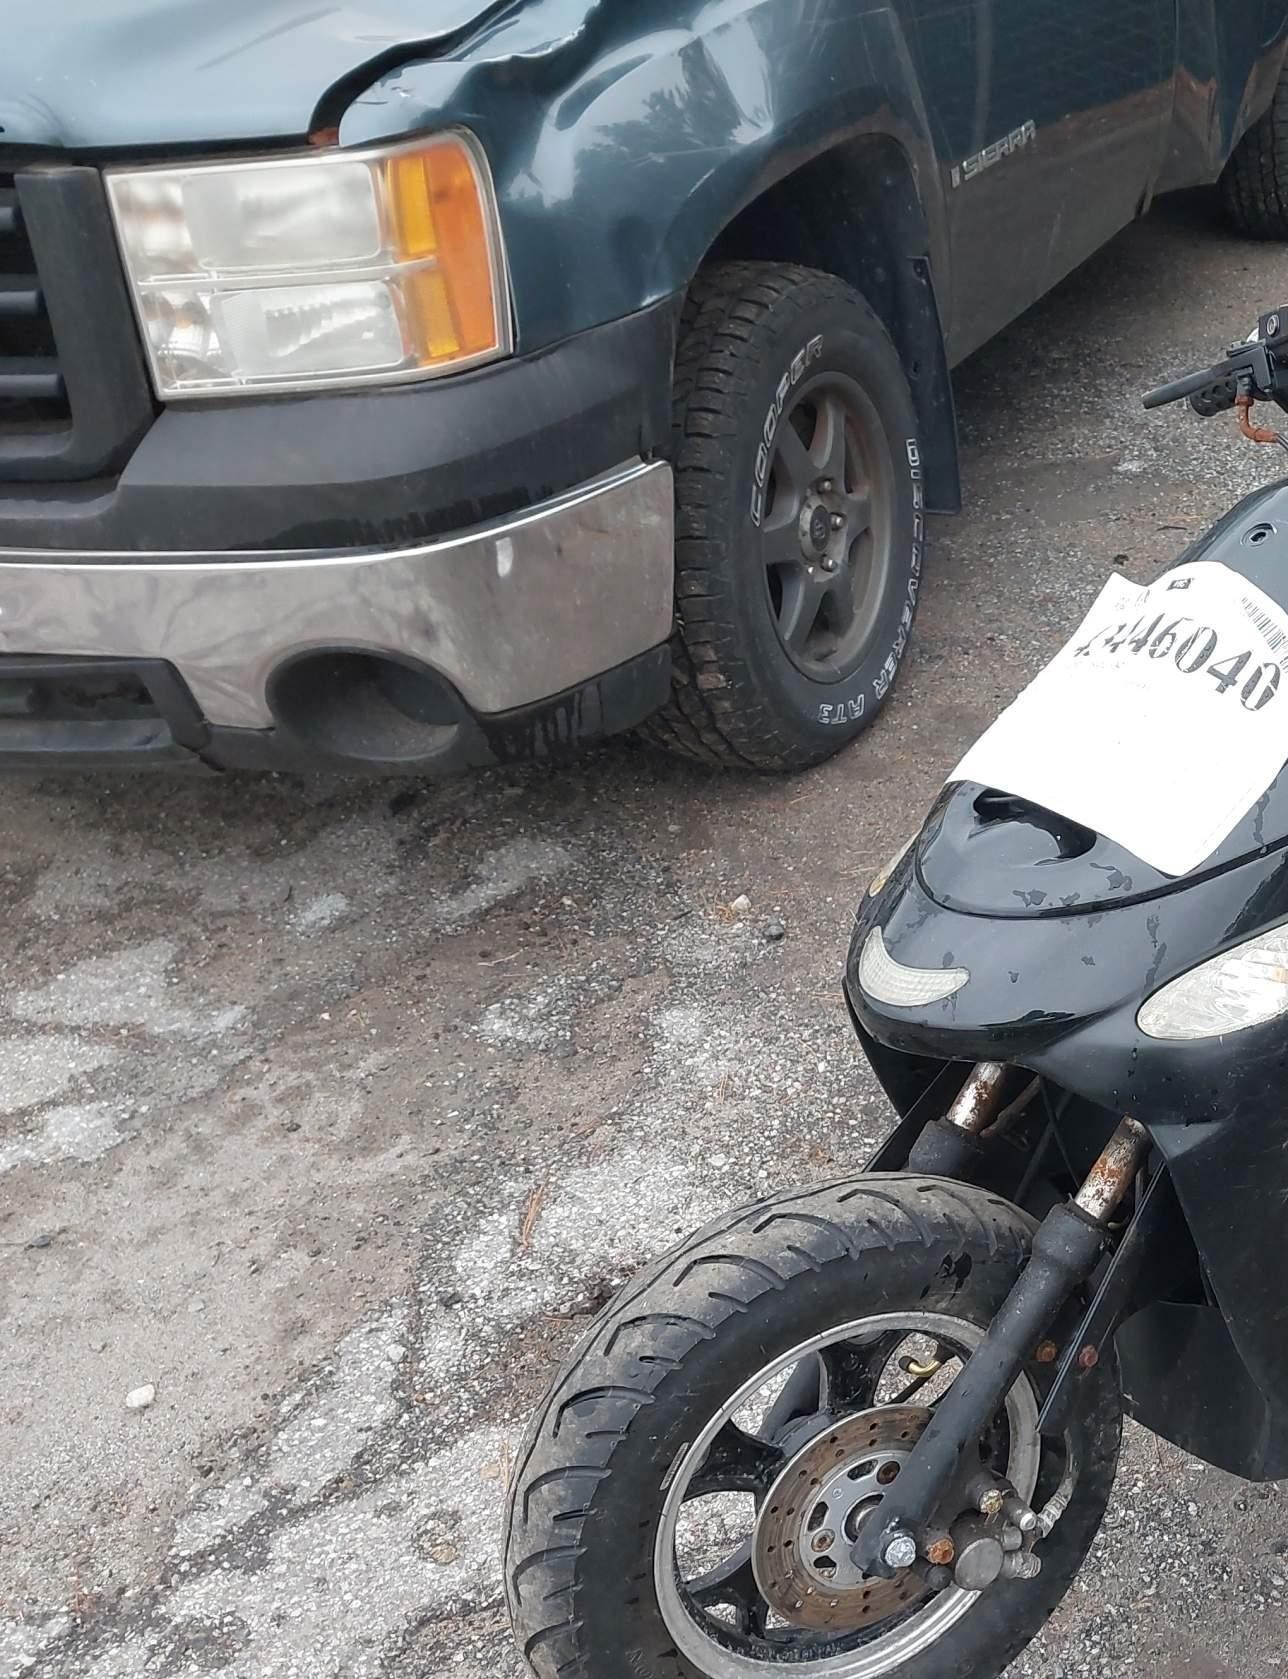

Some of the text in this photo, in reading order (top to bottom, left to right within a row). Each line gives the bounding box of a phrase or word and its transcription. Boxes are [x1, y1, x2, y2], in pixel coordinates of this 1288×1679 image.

[962, 119, 1037, 181] SIERRA
[750, 334, 824, 527] COOPER
[872, 437, 924, 700] DISCOVERER
